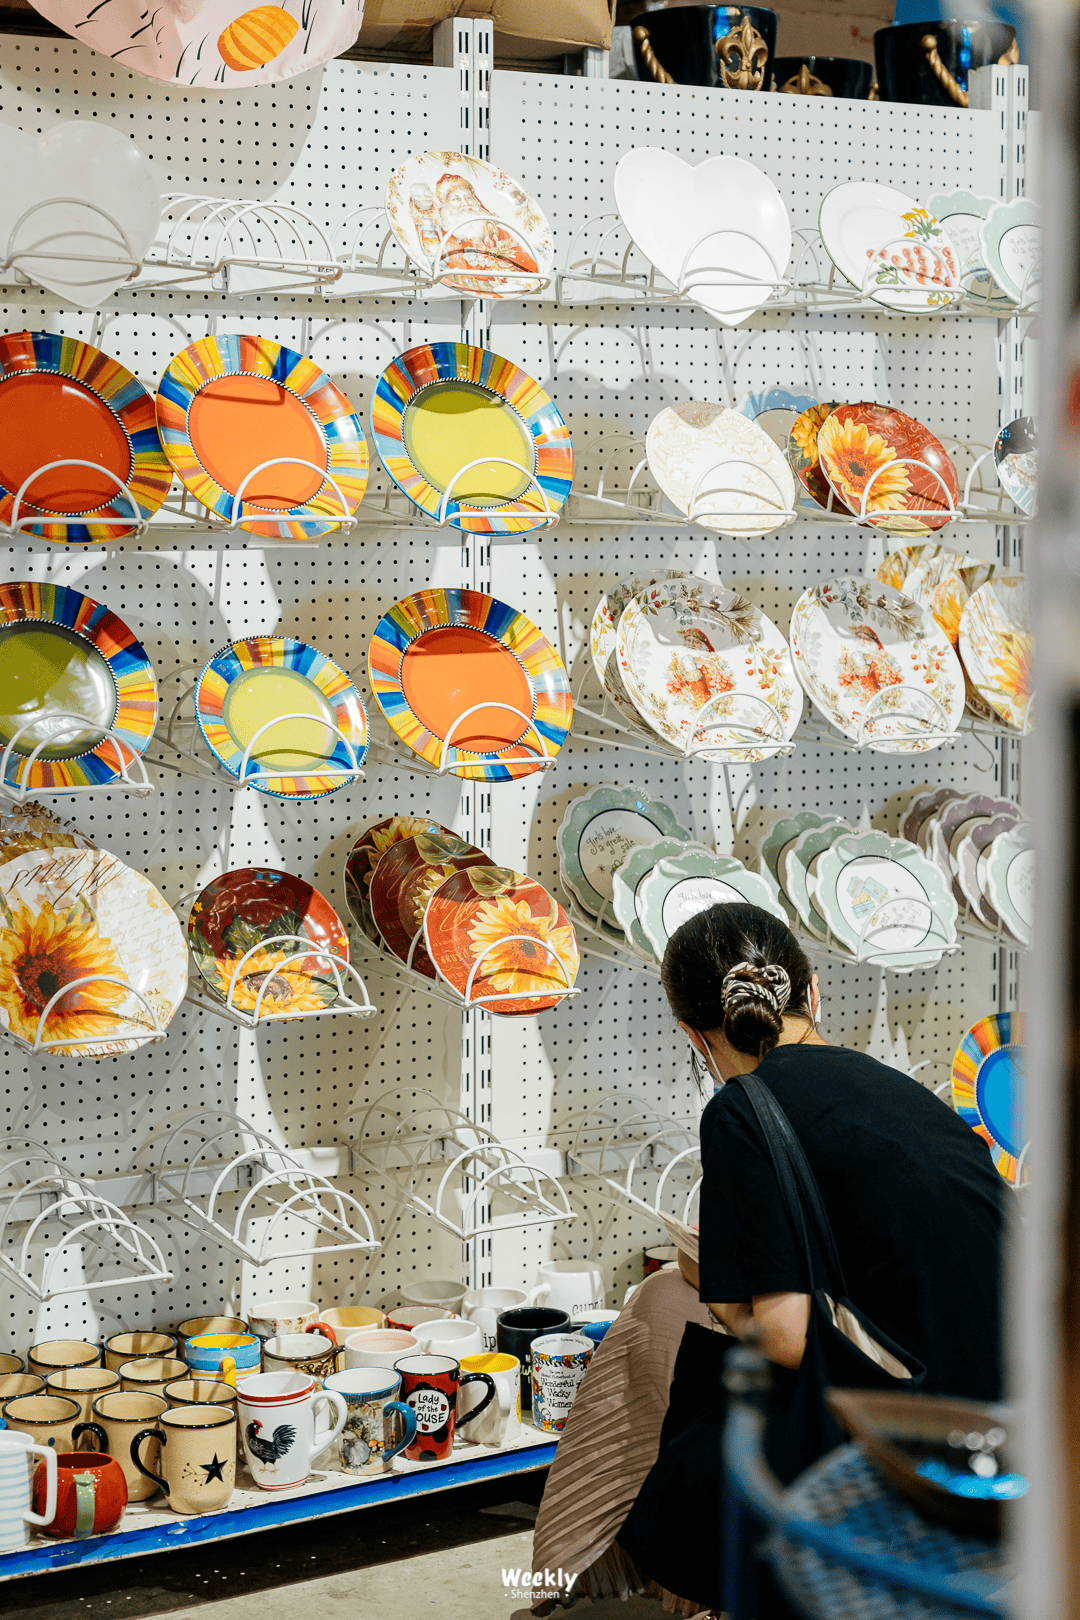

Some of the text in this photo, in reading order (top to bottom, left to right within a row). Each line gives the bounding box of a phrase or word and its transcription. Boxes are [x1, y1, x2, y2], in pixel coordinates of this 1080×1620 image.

[586, 830, 604, 855] girls
[541, 1377, 575, 1388] Wonderful
[418, 1393, 440, 1405] Lady
[547, 1388, 572, 1400] Wacky
[418, 1404, 427, 1412] of
[416, 1412, 446, 1424] OUSE
